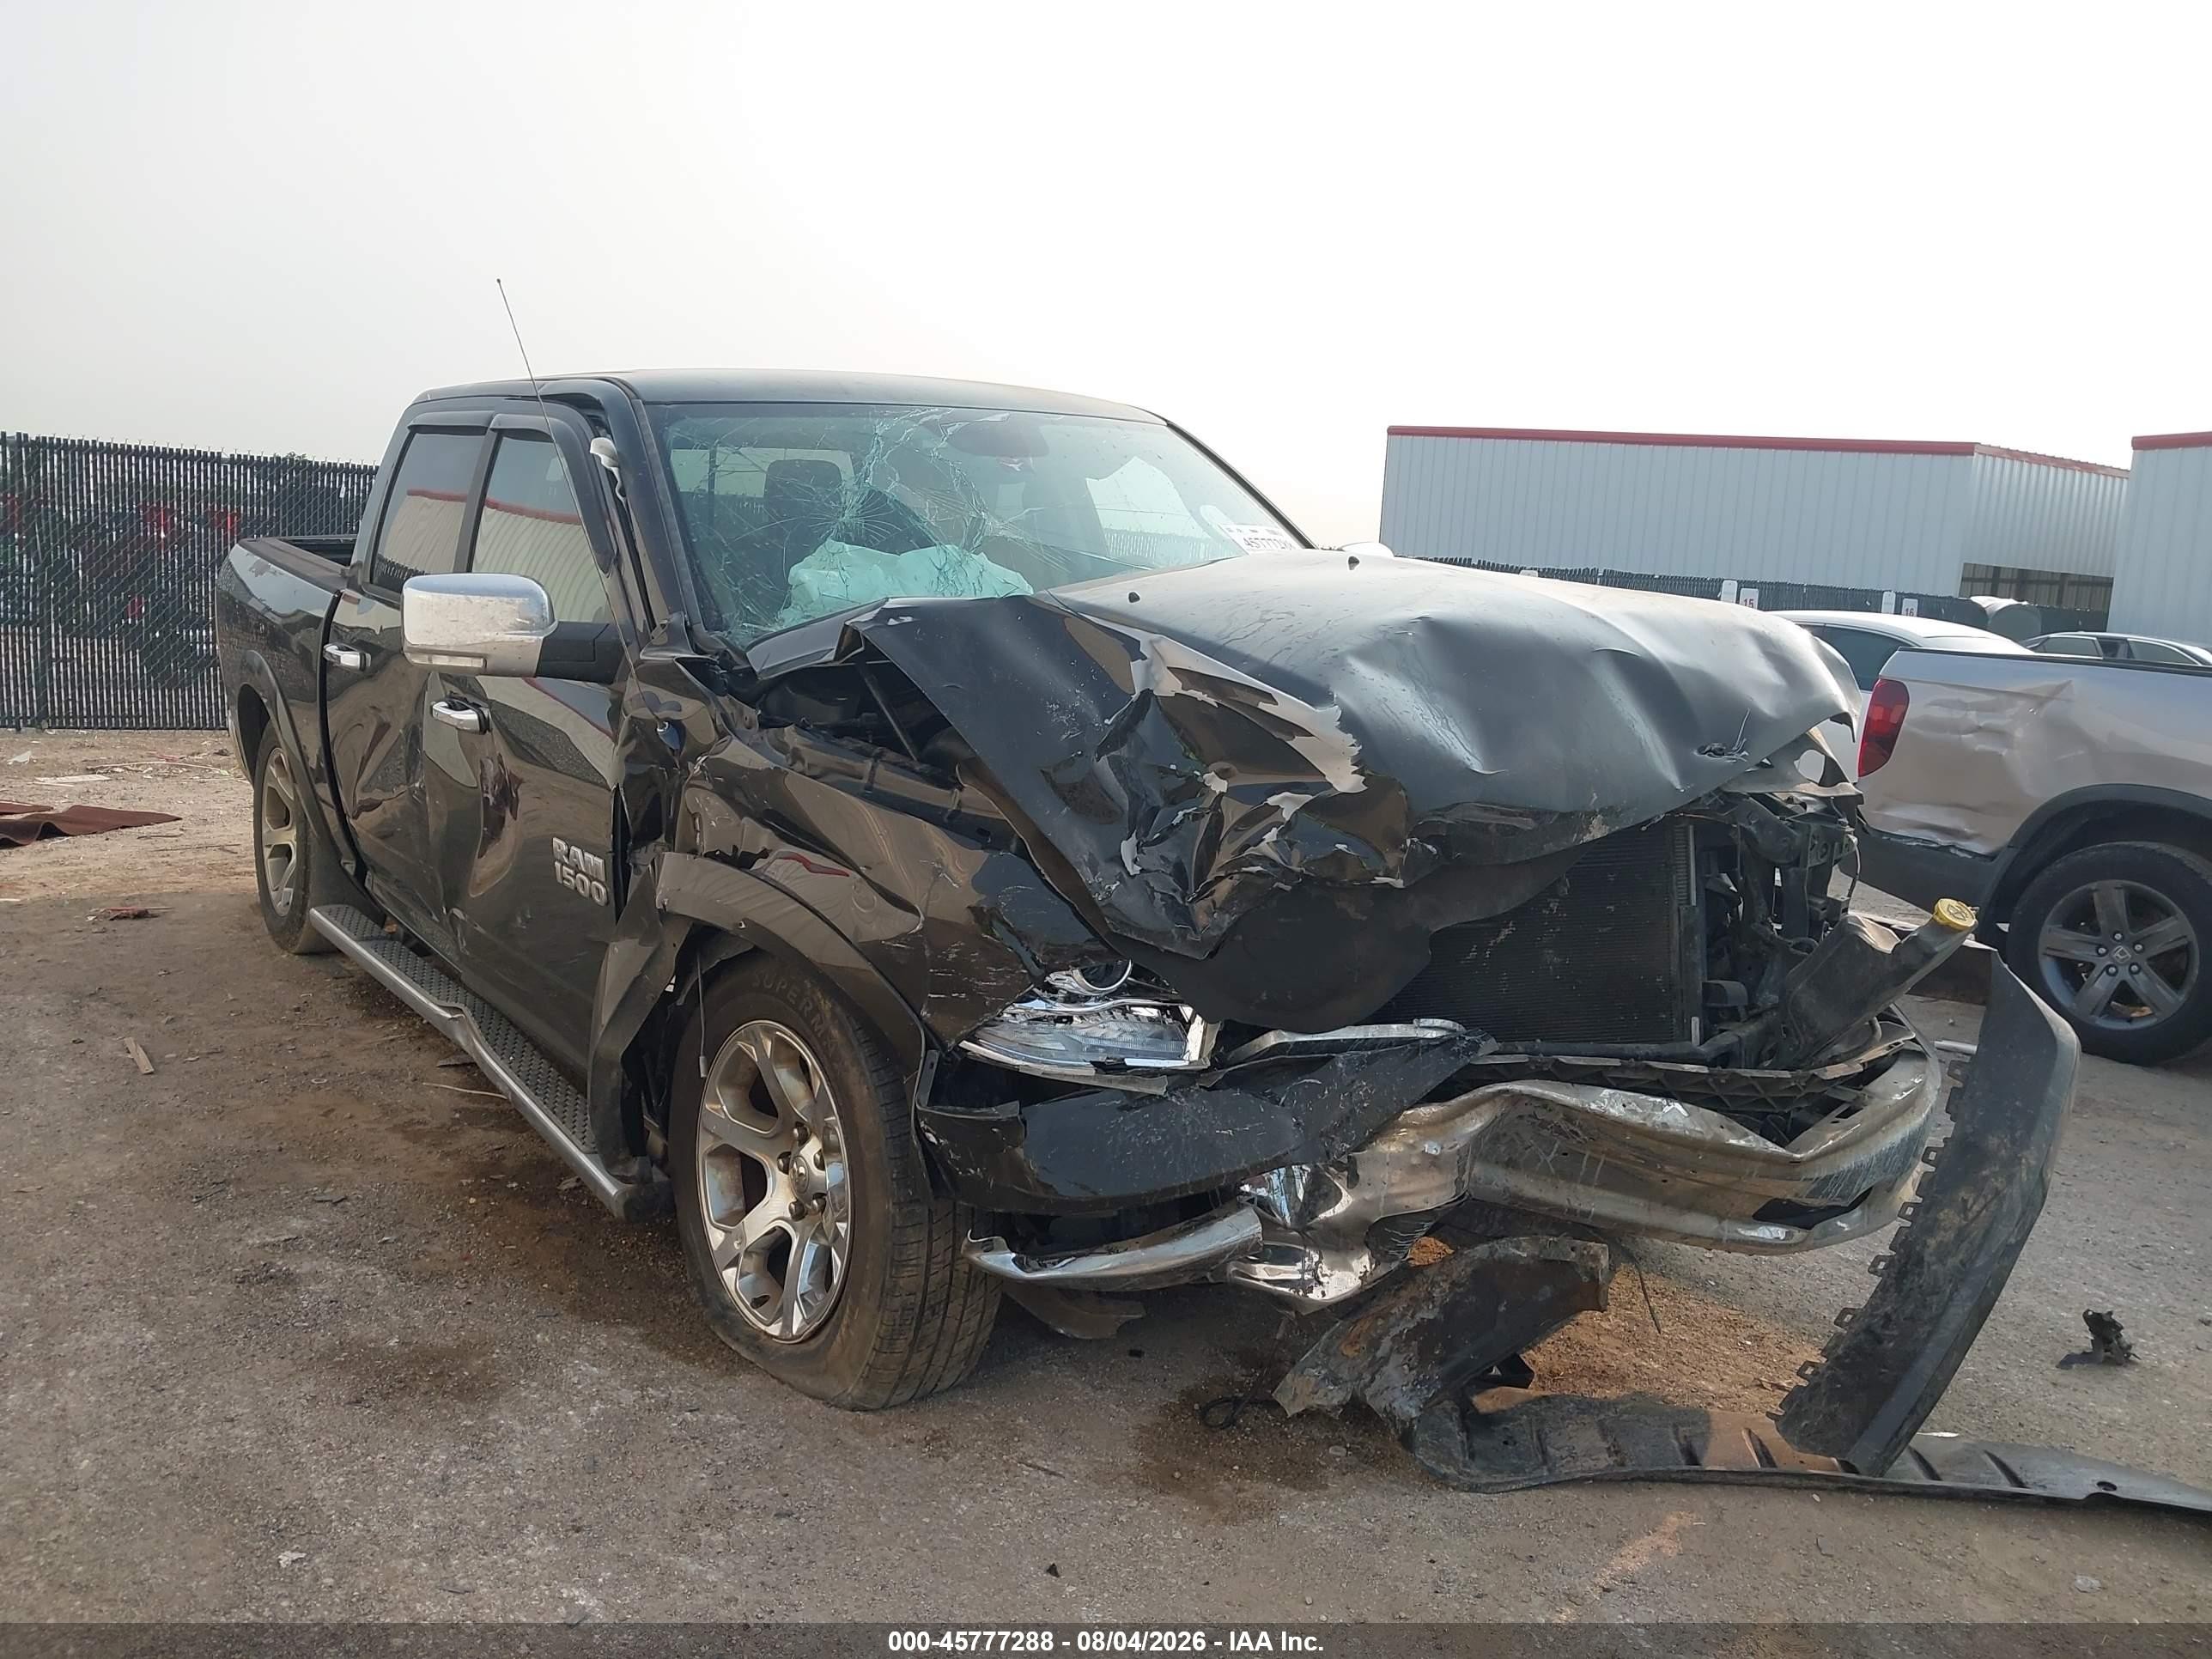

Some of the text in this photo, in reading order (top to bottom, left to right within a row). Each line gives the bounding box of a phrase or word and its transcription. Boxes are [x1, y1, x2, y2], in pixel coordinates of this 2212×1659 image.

[1243, 537, 1293, 550] 457772
[1905, 607, 1915, 617] 16
[552, 837, 606, 882] RAM
[554, 860, 609, 907] 1500
